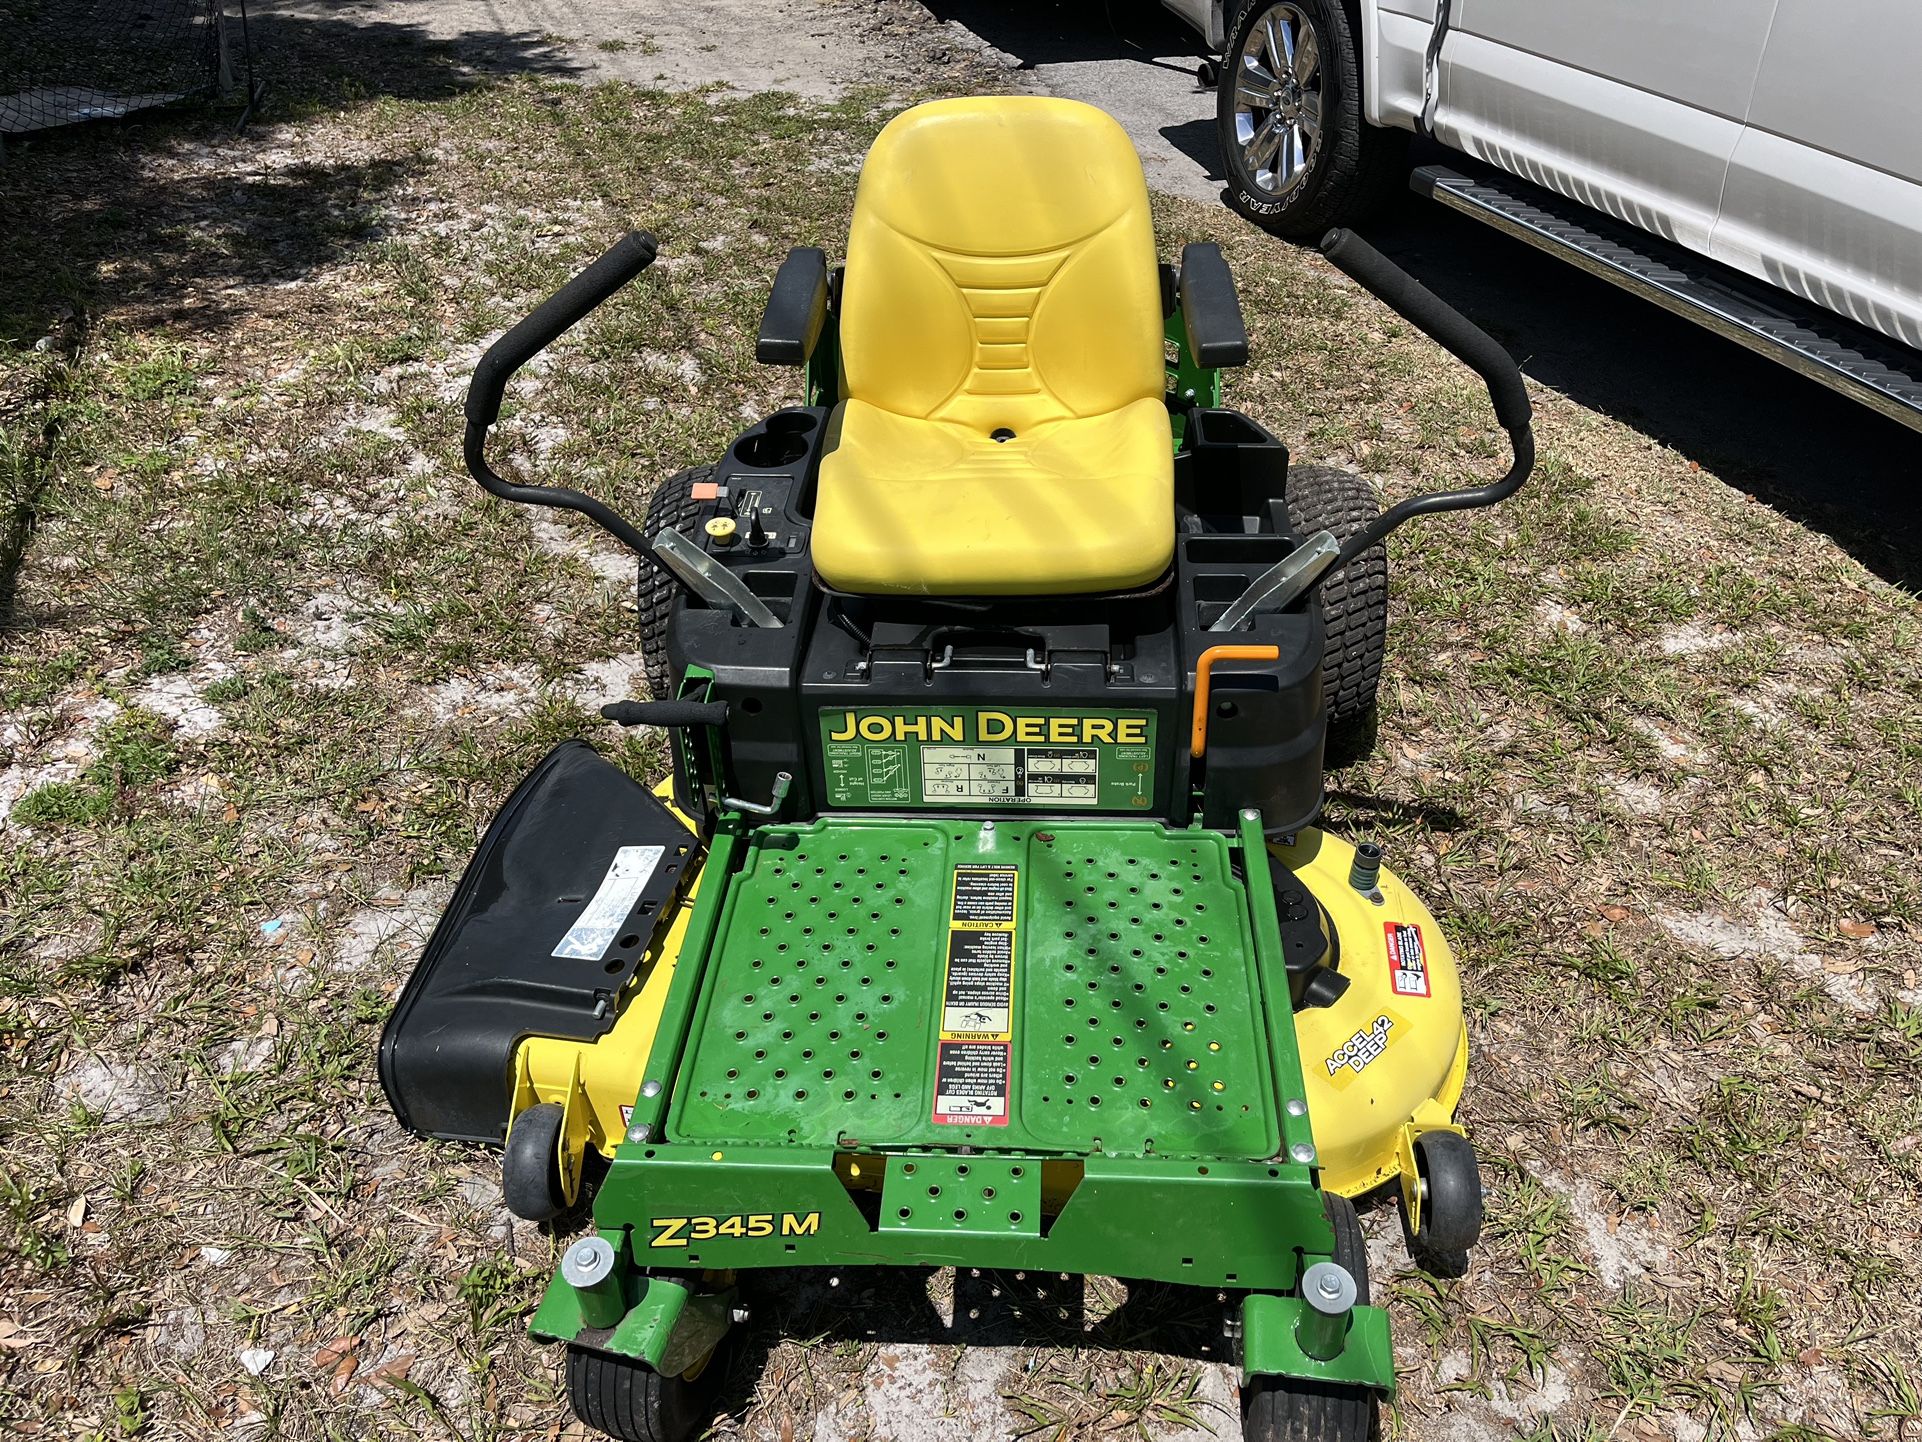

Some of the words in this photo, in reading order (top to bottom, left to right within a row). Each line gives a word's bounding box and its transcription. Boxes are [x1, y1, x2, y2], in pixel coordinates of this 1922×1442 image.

[1238, 130, 1323, 215] GOODYEAR
[830, 711, 965, 743] JOHN
[976, 711, 1149, 744] DEERE
[1387, 933, 1397, 955] DANGER
[1347, 1032, 1387, 1073] DEEP
[947, 1115, 982, 1124] DANGER
[650, 1213, 775, 1248] Z345
[781, 1213, 821, 1236] M
